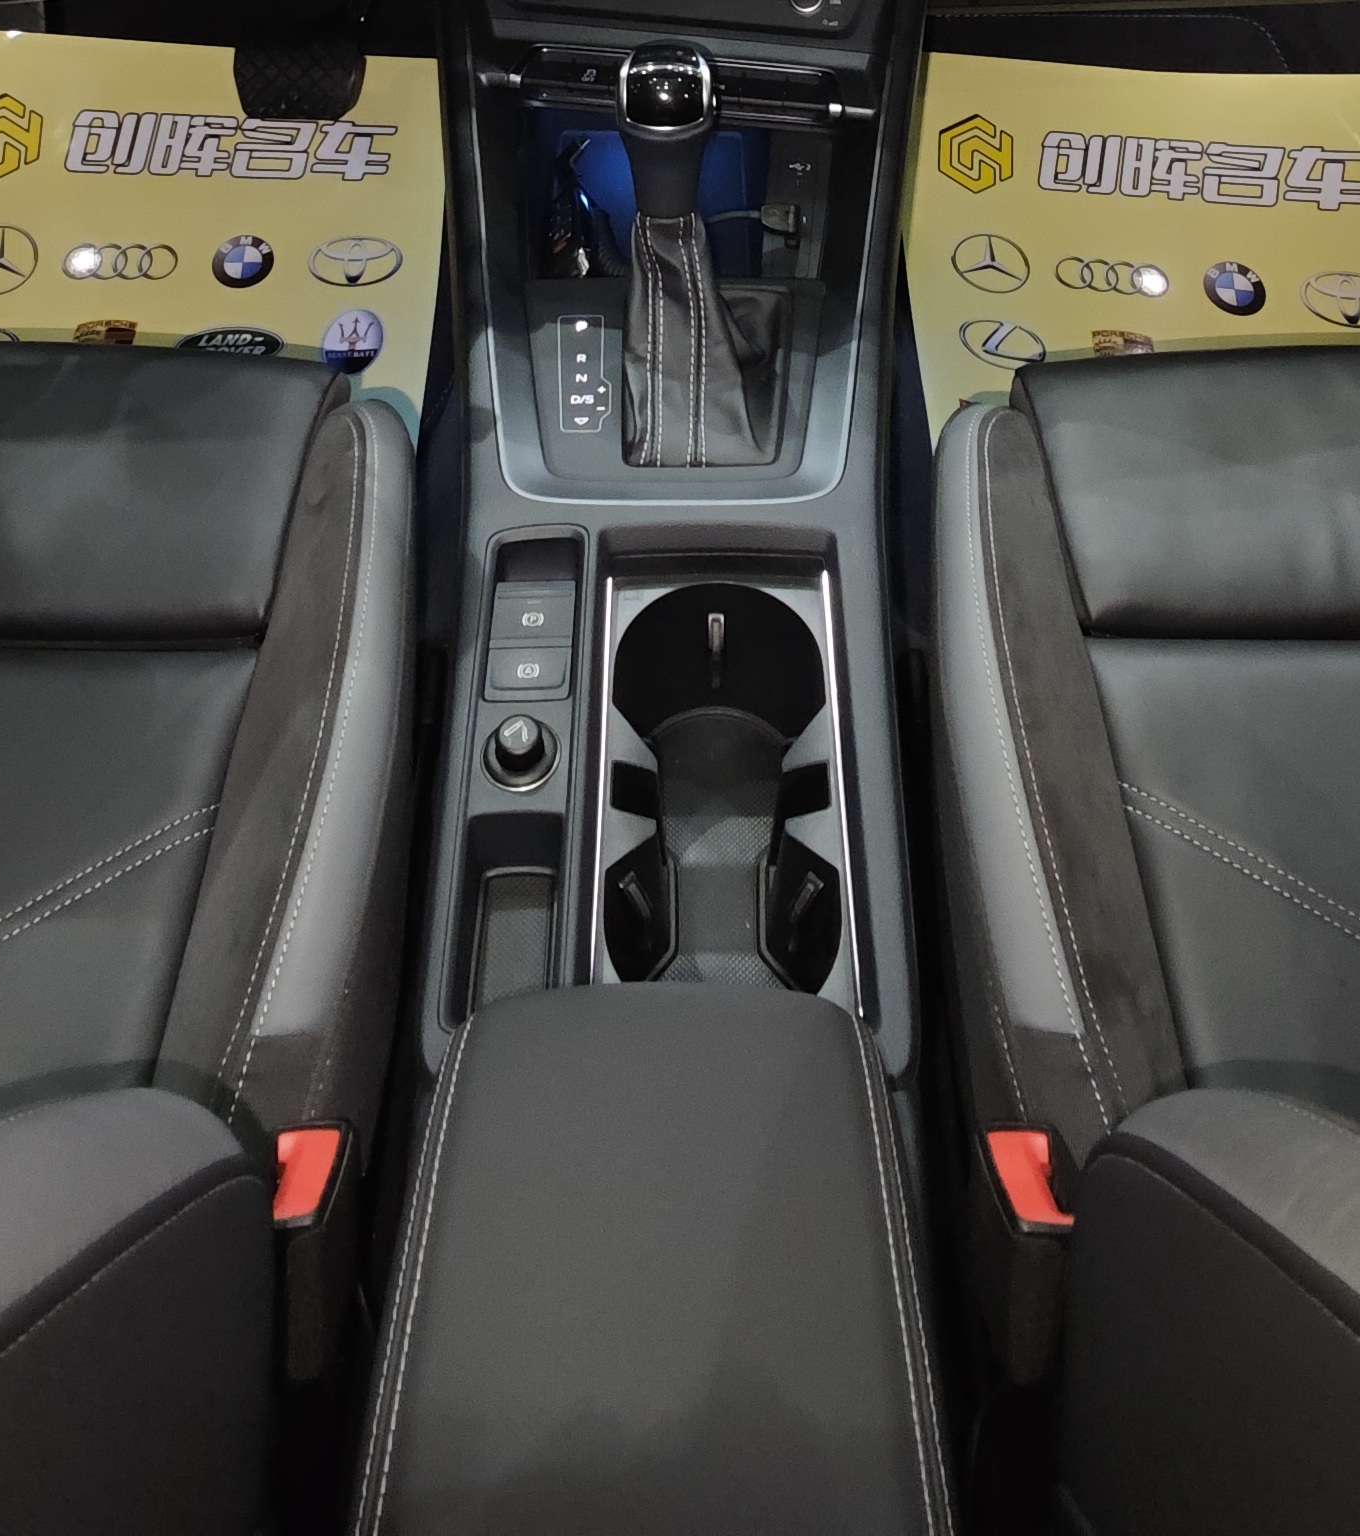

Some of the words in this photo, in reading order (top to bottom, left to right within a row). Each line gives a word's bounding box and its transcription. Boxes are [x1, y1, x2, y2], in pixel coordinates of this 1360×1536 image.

[64, 109, 399, 182] 创晖名车
[219, 235, 272, 255] BMW
[1206, 262, 1261, 284] BMW
[576, 321, 588, 333] P
[197, 334, 266, 348] LAND-
[576, 354, 587, 364] R
[575, 373, 588, 383] N
[570, 394, 595, 405] D/S
